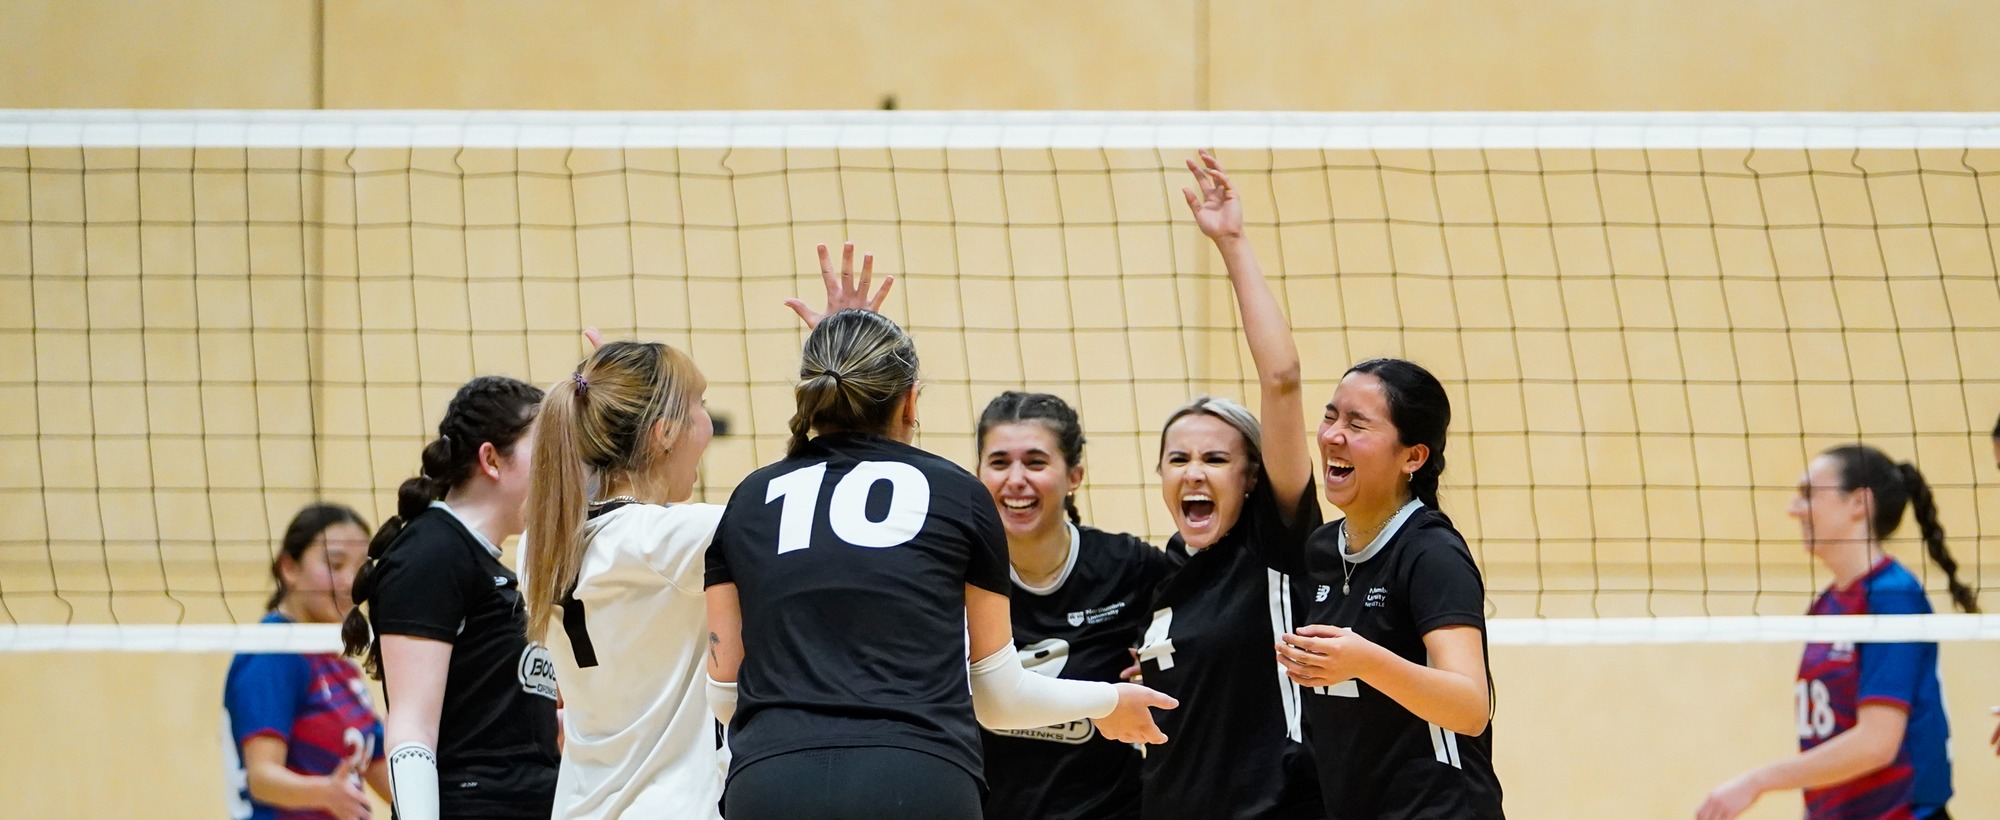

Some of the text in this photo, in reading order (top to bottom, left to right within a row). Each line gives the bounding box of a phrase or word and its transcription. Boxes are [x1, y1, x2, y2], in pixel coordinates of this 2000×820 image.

[765, 461, 930, 555] 10
[1138, 606, 1176, 671] 4
[529, 657, 557, 681] BOO
[1010, 729, 1064, 741] DRINKS
[1795, 678, 1836, 738] 18
